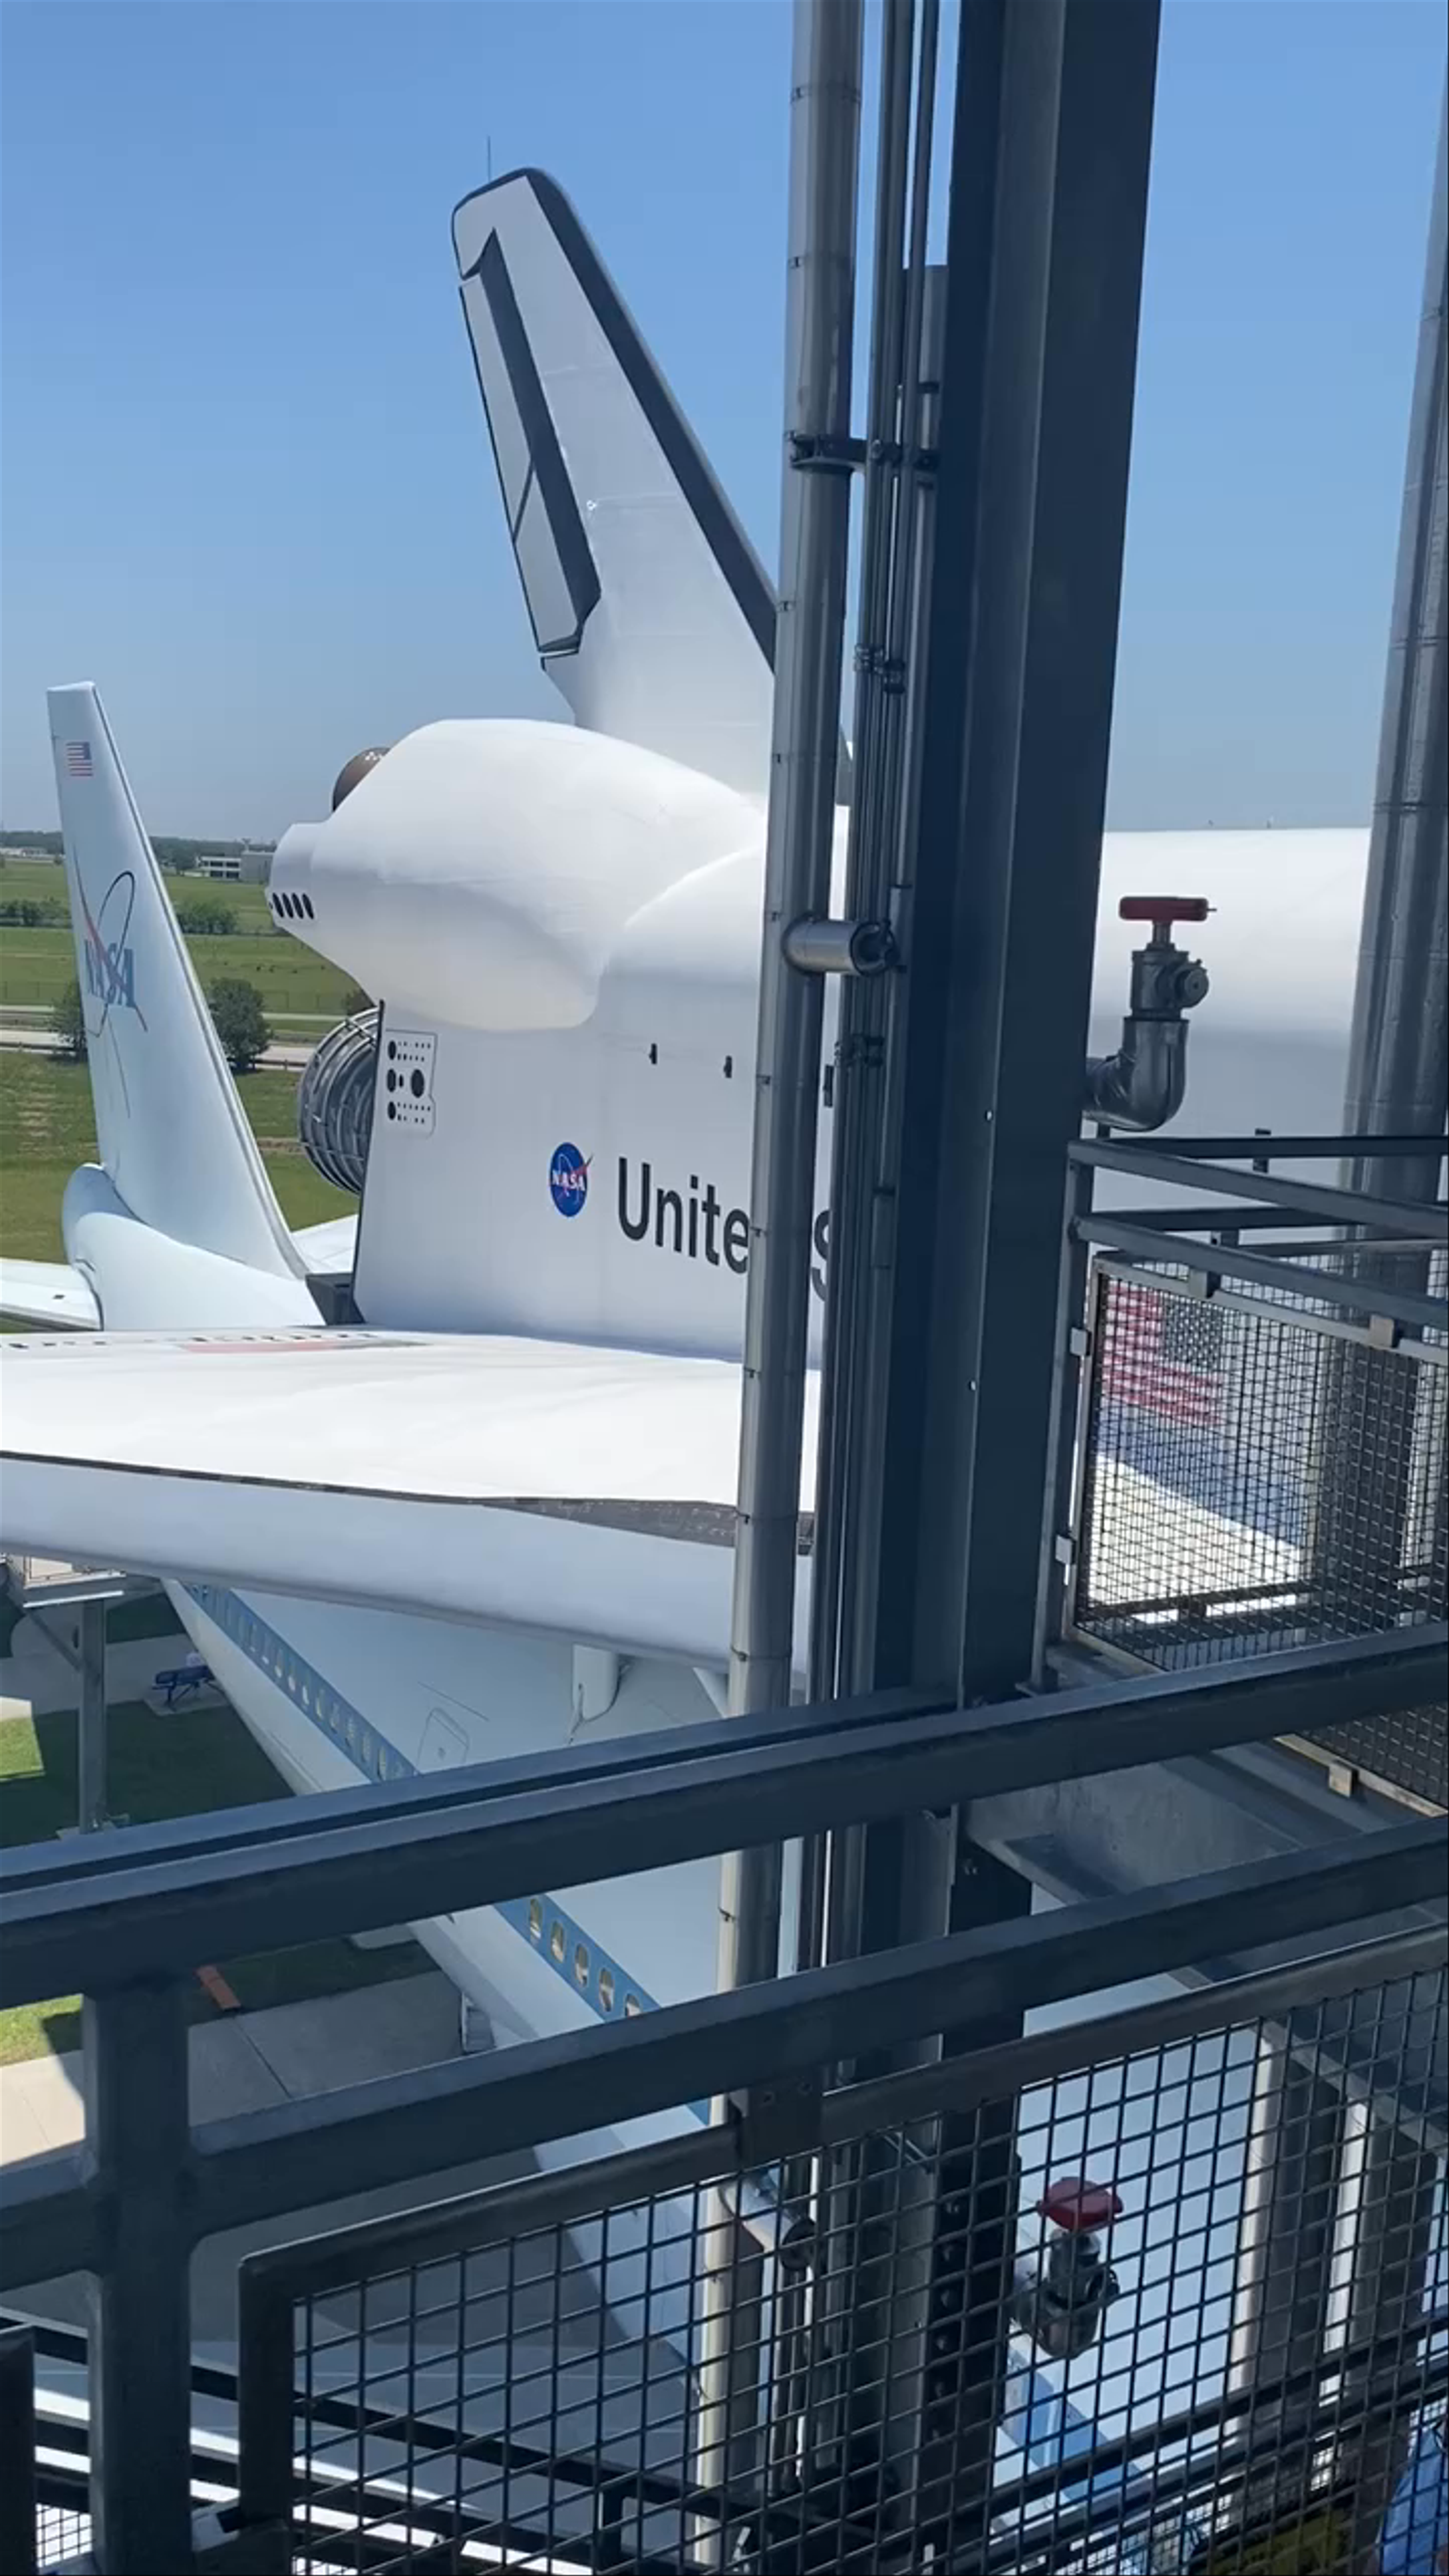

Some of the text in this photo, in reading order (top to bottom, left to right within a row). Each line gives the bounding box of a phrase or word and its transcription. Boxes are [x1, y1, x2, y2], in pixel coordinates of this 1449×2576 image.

[85, 939, 136, 1009] NASA
[552, 1169, 585, 1191] NASA
[618, 1157, 750, 1274] Unite
